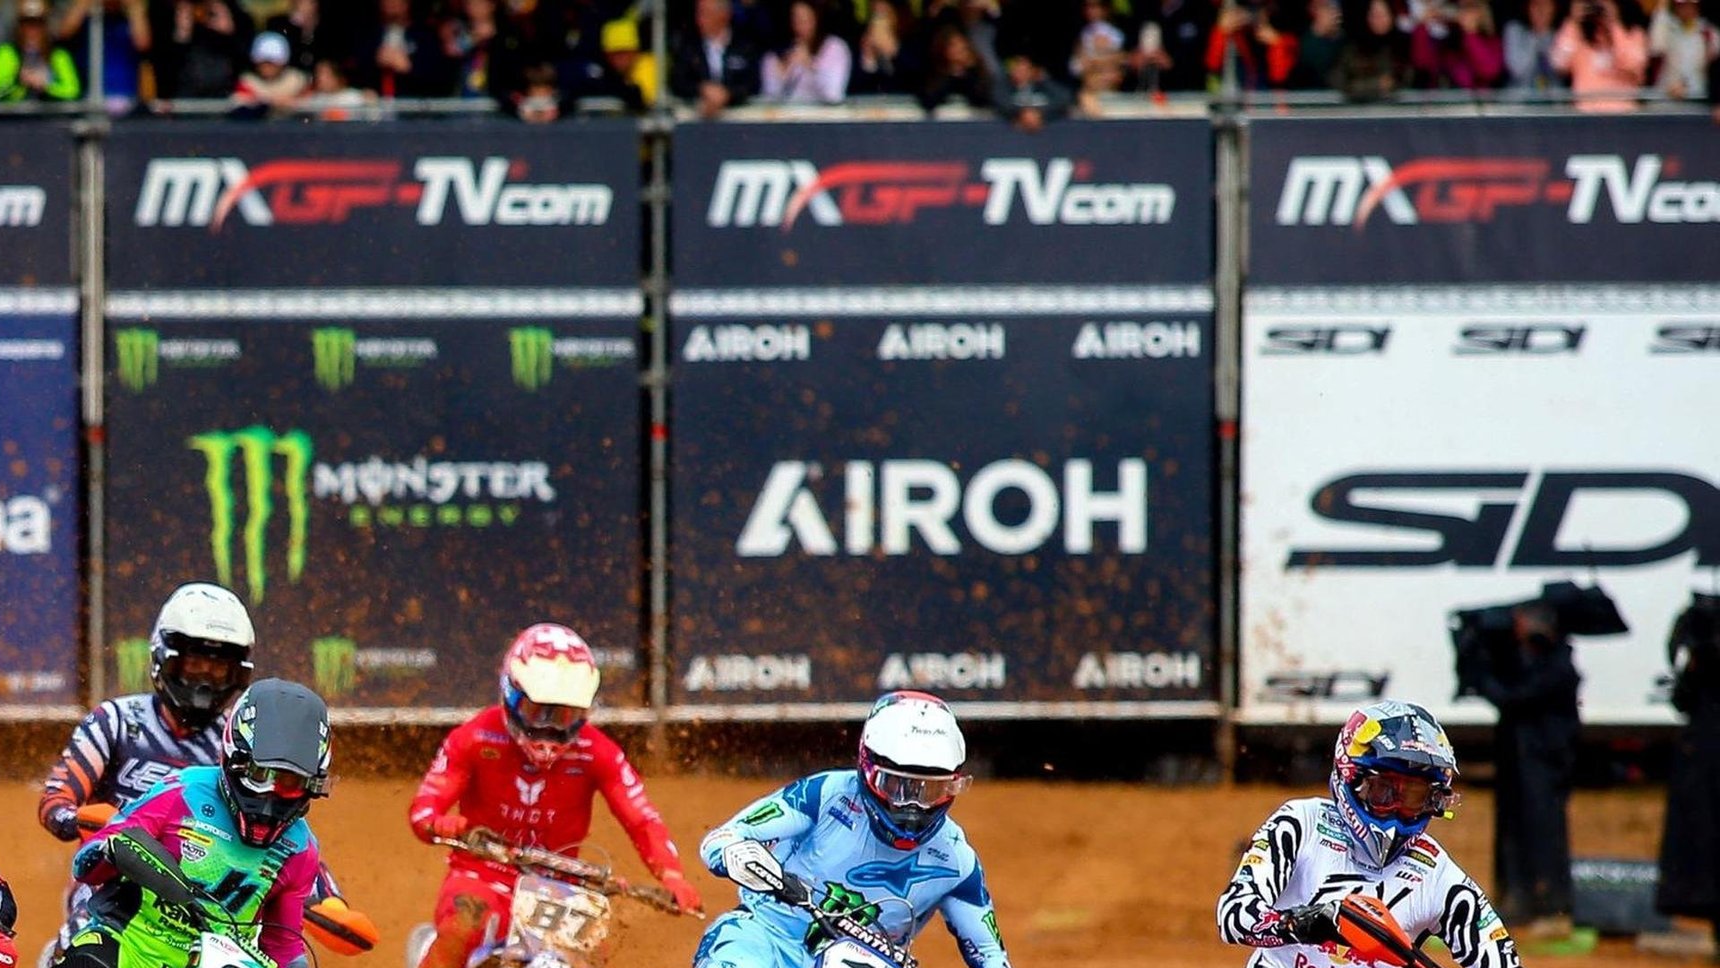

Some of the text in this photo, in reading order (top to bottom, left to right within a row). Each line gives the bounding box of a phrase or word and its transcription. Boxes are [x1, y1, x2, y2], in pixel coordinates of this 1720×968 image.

[683, 325, 810, 361] AIROH
[879, 323, 1005, 360] AIROH
[1074, 321, 1201, 358] AIROH
[314, 456, 557, 504] MONSTER
[736, 457, 1148, 557] AIROH
[685, 655, 811, 691] AIROH
[880, 653, 1006, 689] AIROH
[1075, 652, 1201, 687] AIROH
[747, 862, 784, 889] ACERBIS
